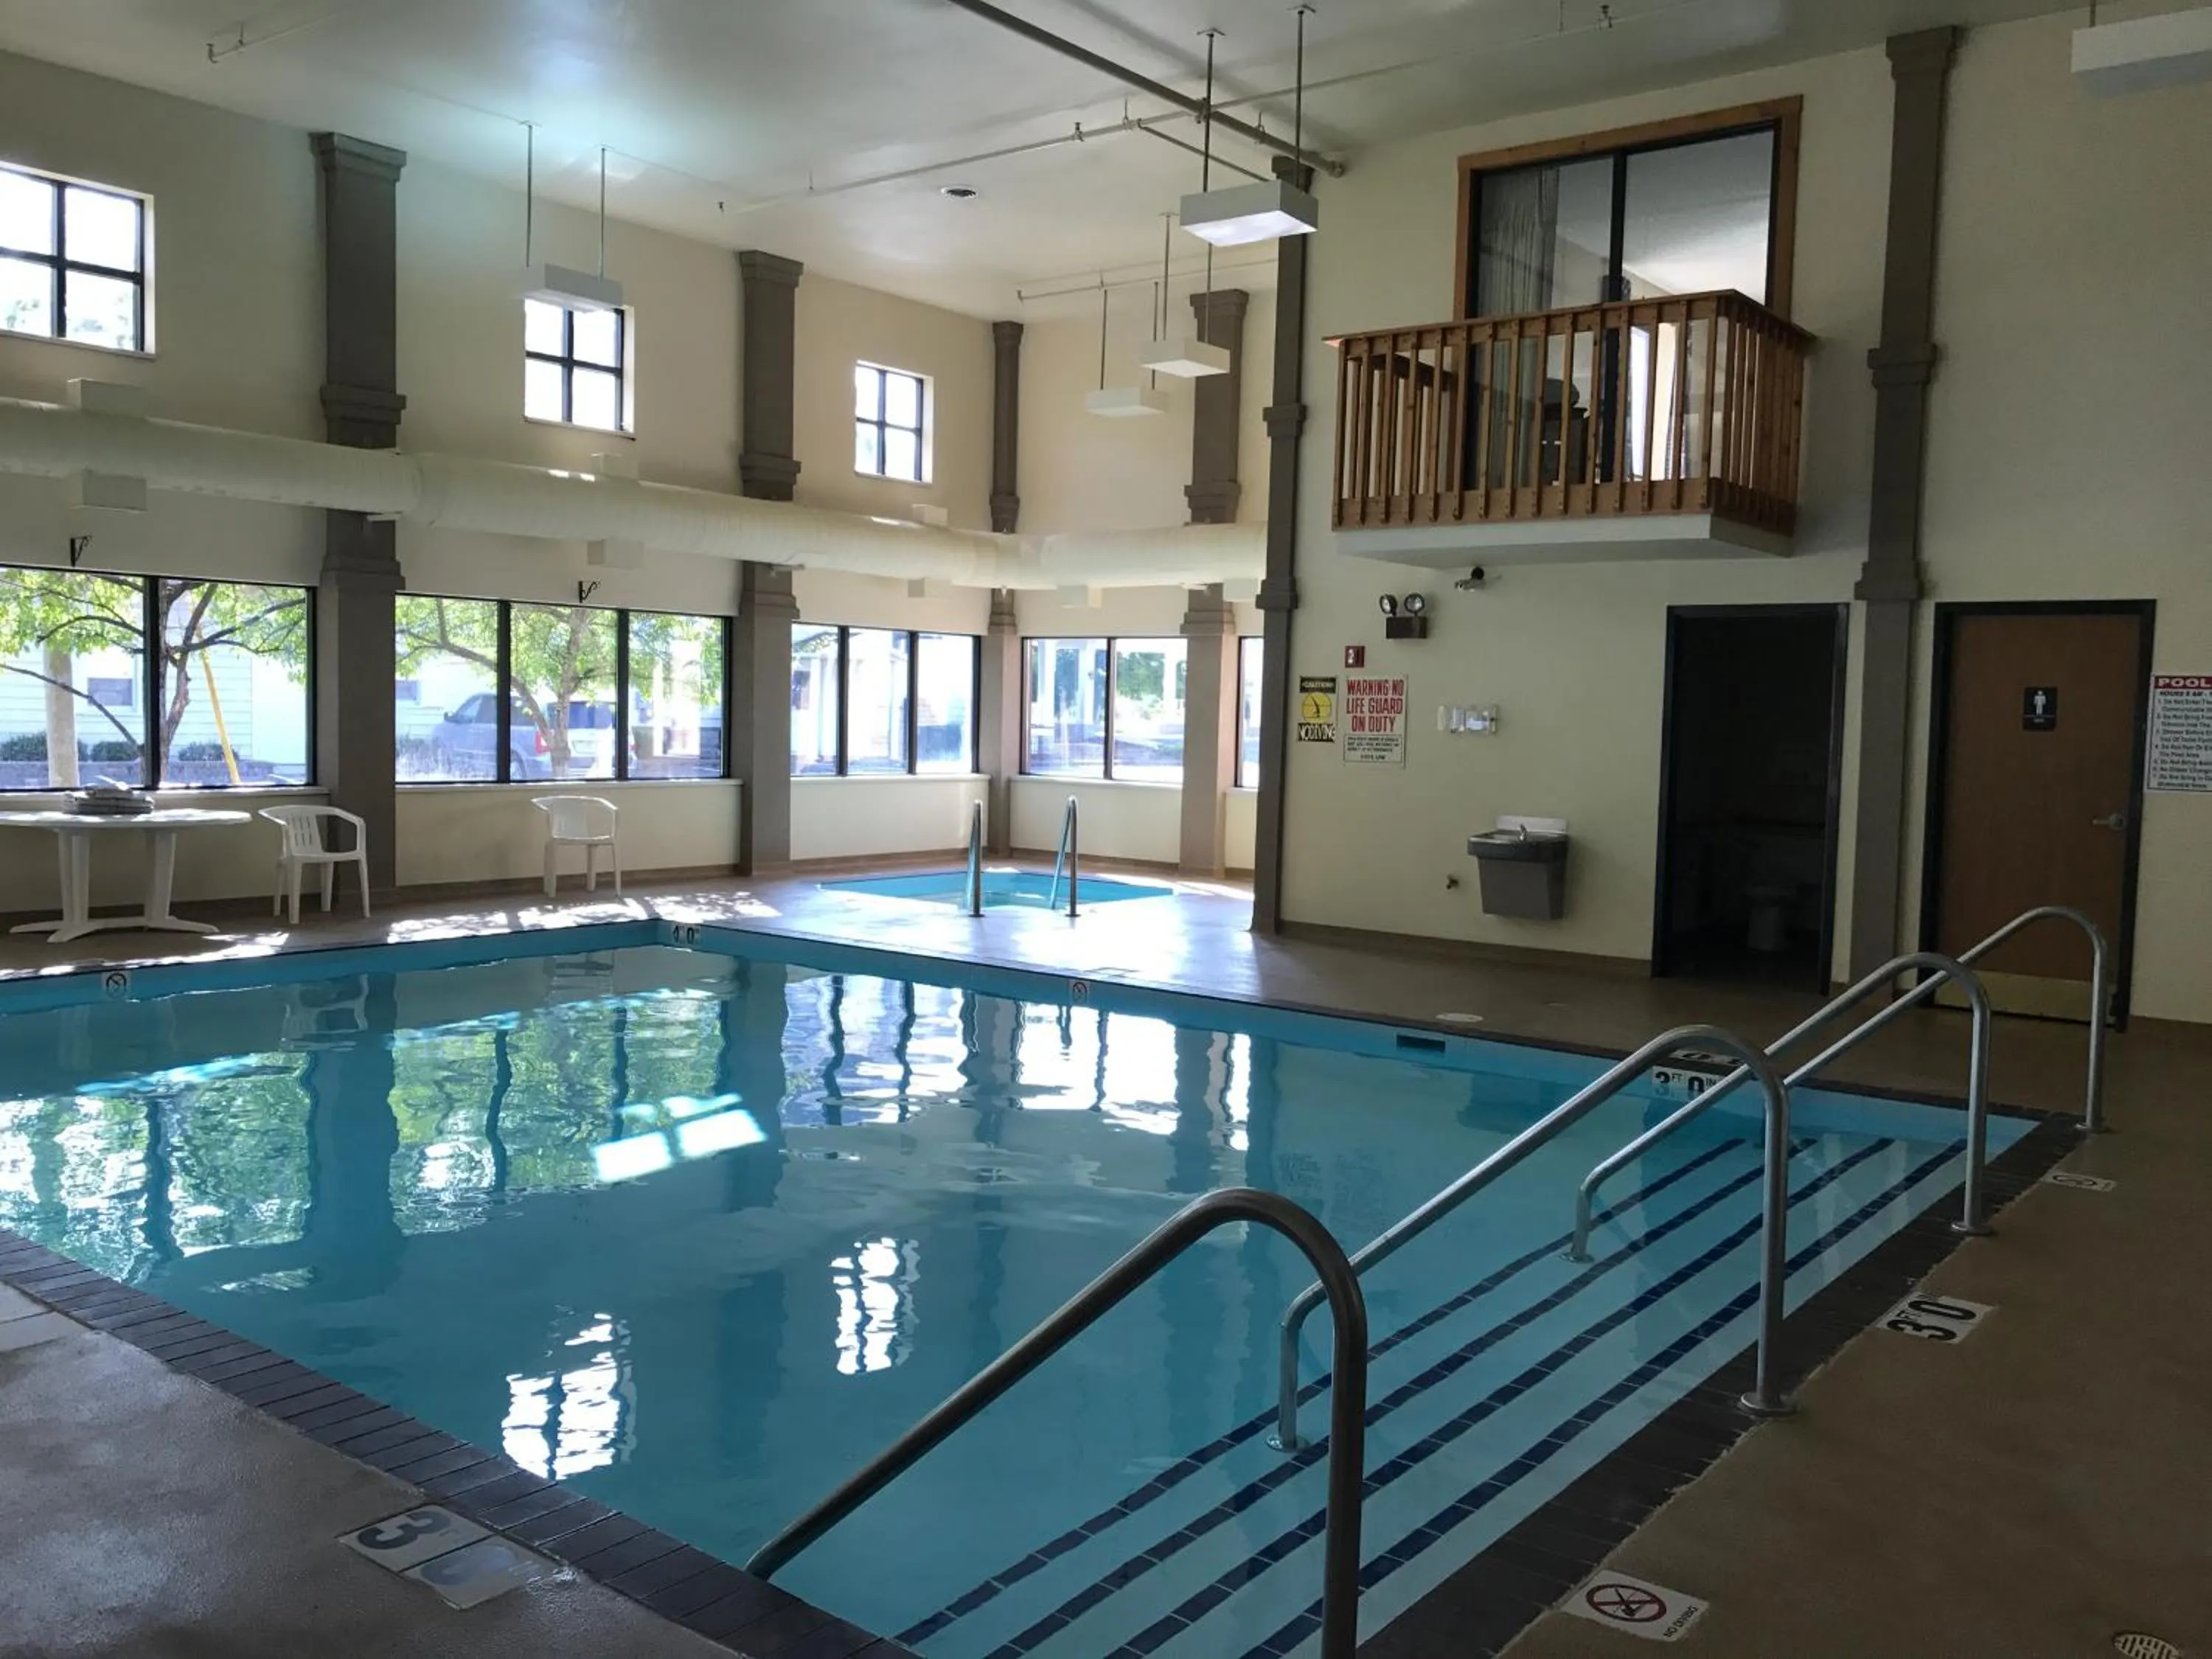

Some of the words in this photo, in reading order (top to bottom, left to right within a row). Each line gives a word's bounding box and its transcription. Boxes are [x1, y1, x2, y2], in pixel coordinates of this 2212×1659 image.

[1347, 679, 1388, 696] WARNING
[1391, 679, 1405, 696] NO
[2158, 678, 2211, 688] POOL
[1346, 698, 1364, 714] LIFE
[1368, 698, 1403, 714] GUARD
[1352, 715, 1365, 732] ON
[1368, 715, 1397, 732] DUTY
[1908, 1300, 1977, 1321] 0
[358, 1512, 451, 1550] 3
